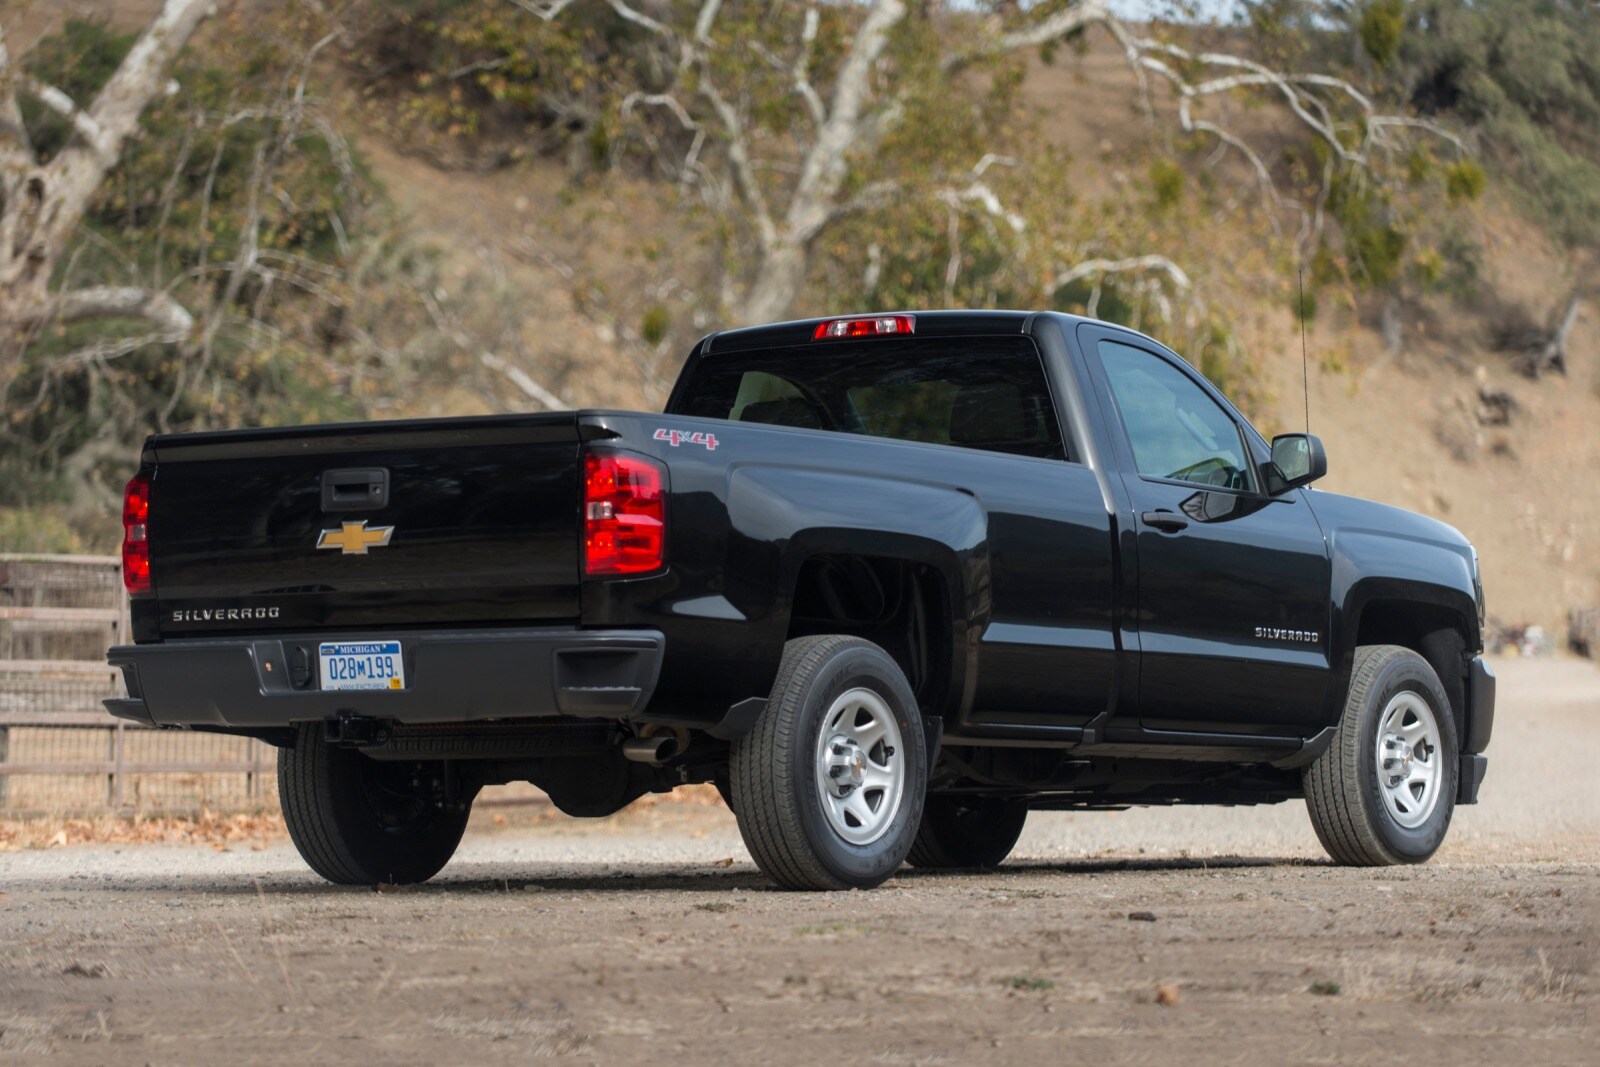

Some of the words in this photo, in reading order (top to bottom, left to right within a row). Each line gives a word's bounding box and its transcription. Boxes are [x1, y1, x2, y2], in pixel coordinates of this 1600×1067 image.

[173, 607, 279, 621] SILVERADO
[1255, 627, 1319, 642] SILVERADO
[340, 645, 381, 654] MICHIGAN
[329, 656, 394, 680] 028M199
